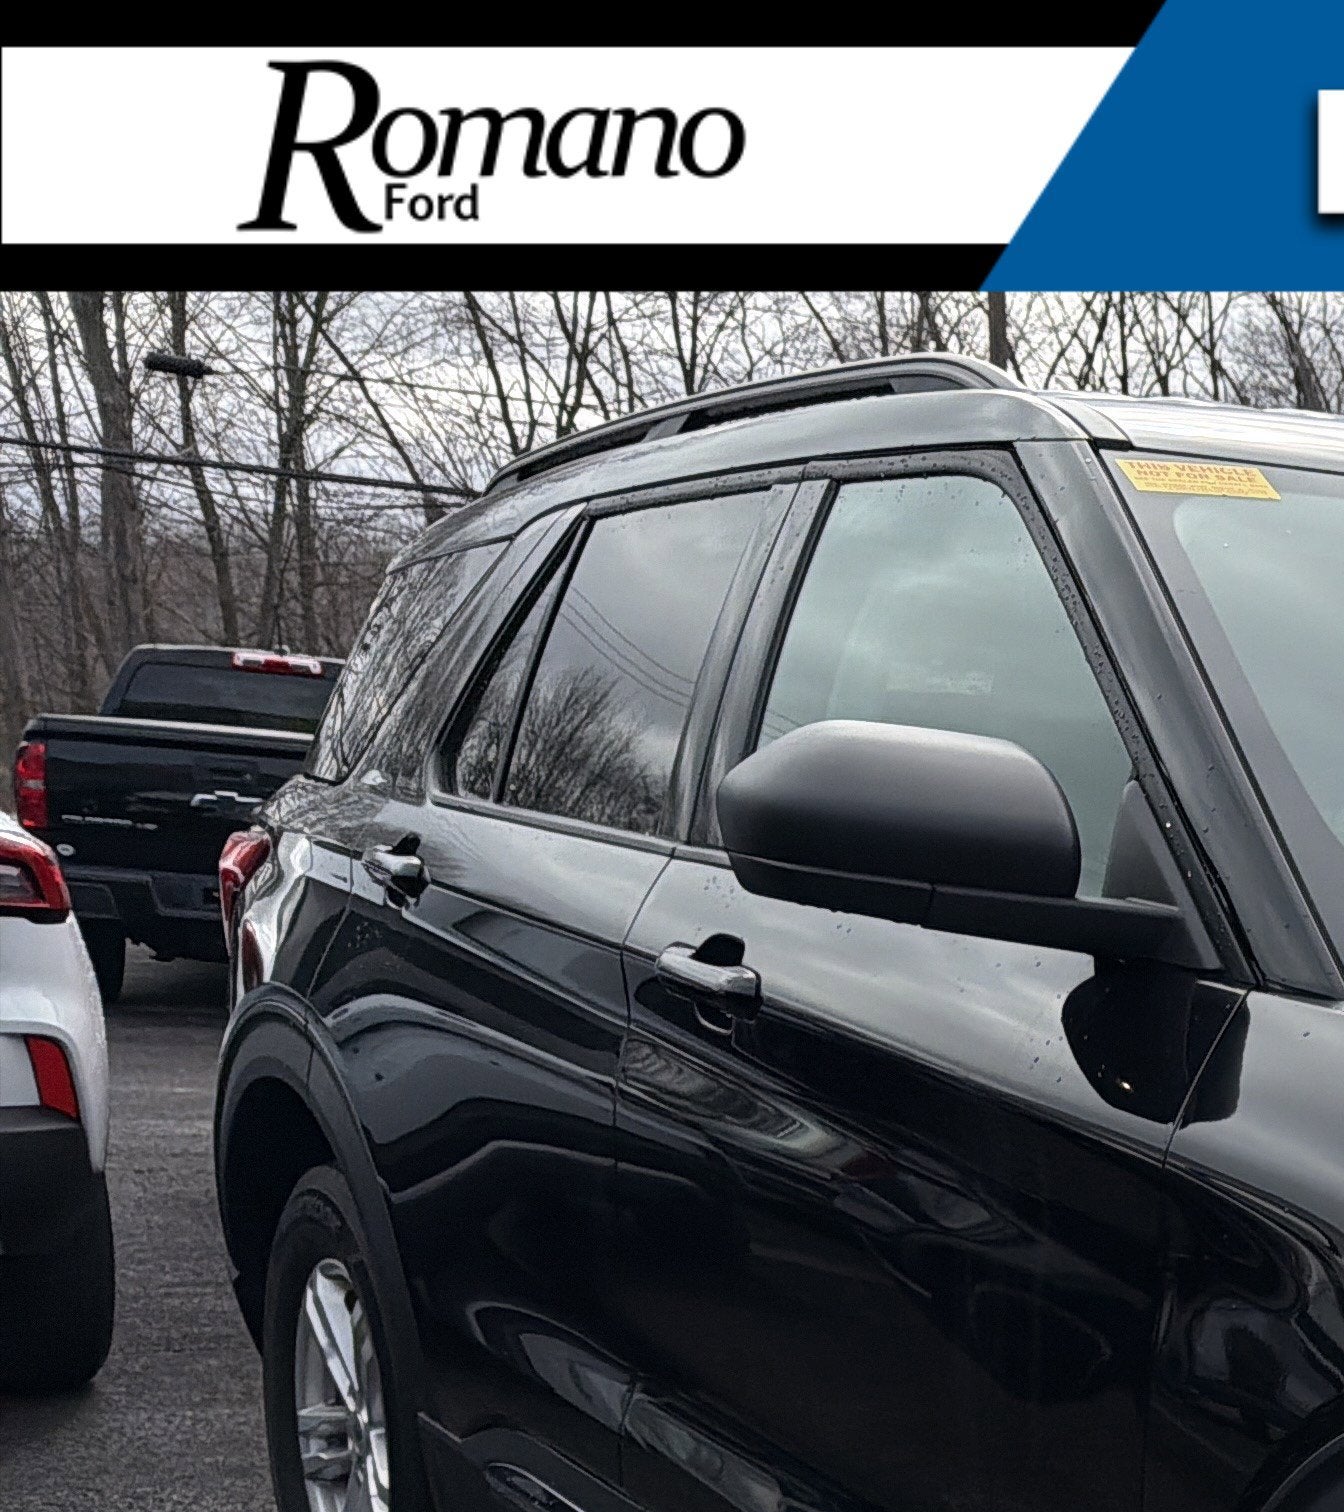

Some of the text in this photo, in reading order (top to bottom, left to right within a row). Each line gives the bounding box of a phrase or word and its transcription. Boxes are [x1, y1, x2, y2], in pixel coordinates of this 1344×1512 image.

[1127, 461, 1257, 477] THIS VEHICLE
[1176, 471, 1209, 480] FOR
[1215, 473, 1257, 483] SALE
